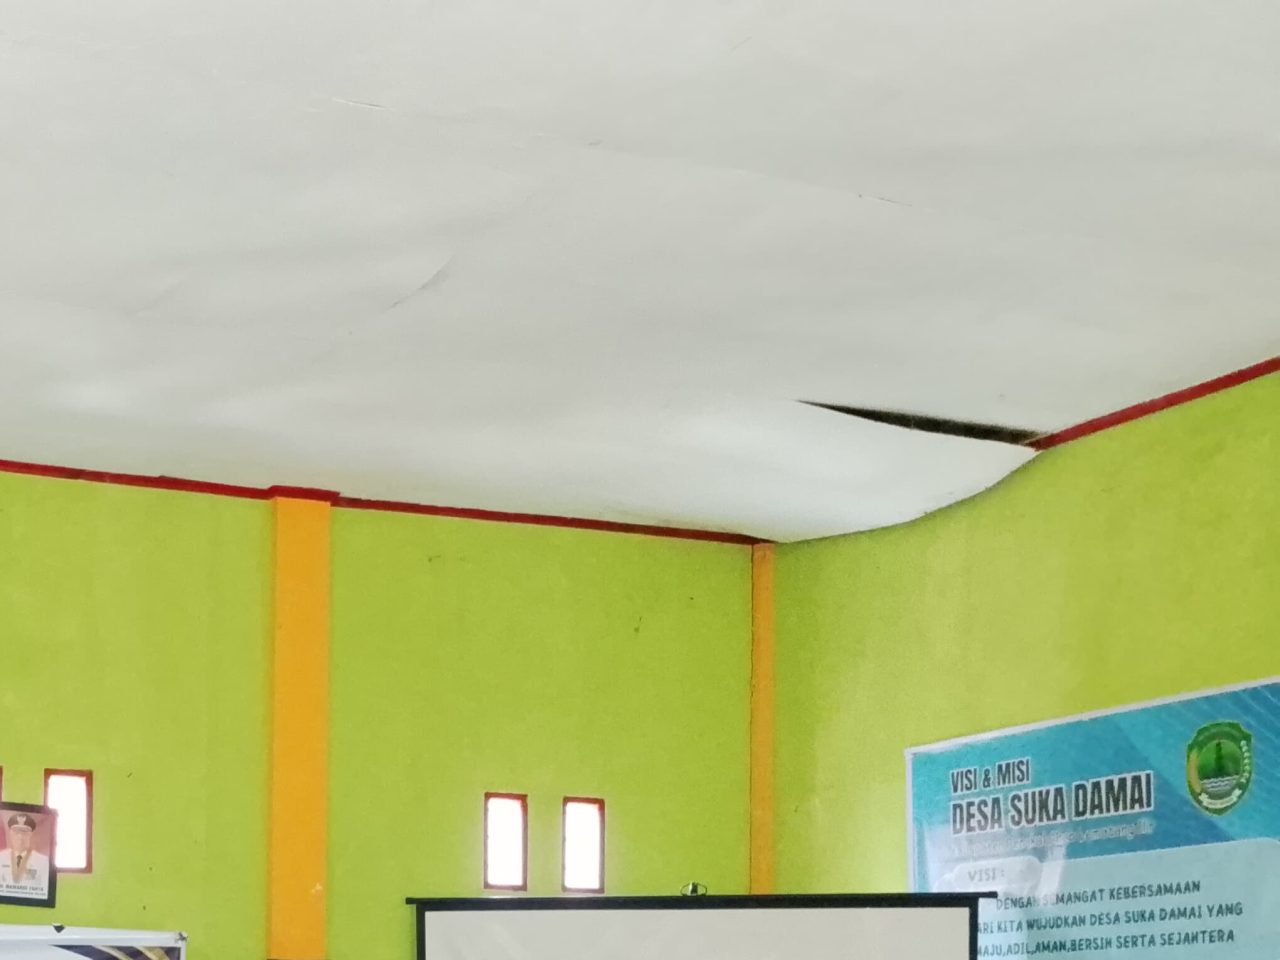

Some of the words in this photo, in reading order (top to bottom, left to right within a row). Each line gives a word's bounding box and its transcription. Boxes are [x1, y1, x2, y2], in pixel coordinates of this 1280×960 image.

[951, 768, 978, 794] VISI
[982, 768, 992, 789] &
[996, 758, 1030, 786] MISI
[952, 797, 1004, 835] DESA
[1009, 787, 1066, 827] SUKA
[1073, 773, 1153, 818] DAMAI
[1109, 880, 1201, 901] KEBERSAMAAN
[977, 921, 994, 935] ARI
[997, 920, 1023, 934] KITA
[1026, 914, 1086, 931] WUJUDKAN
[1089, 911, 1121, 927] DESA
[1124, 909, 1155, 924] SUKA
[1159, 905, 1203, 922] DAMAI
[1206, 901, 1244, 918] YANG
[1116, 933, 1156, 950] SERTA
[1160, 929, 1236, 947] SEJAHTERA
